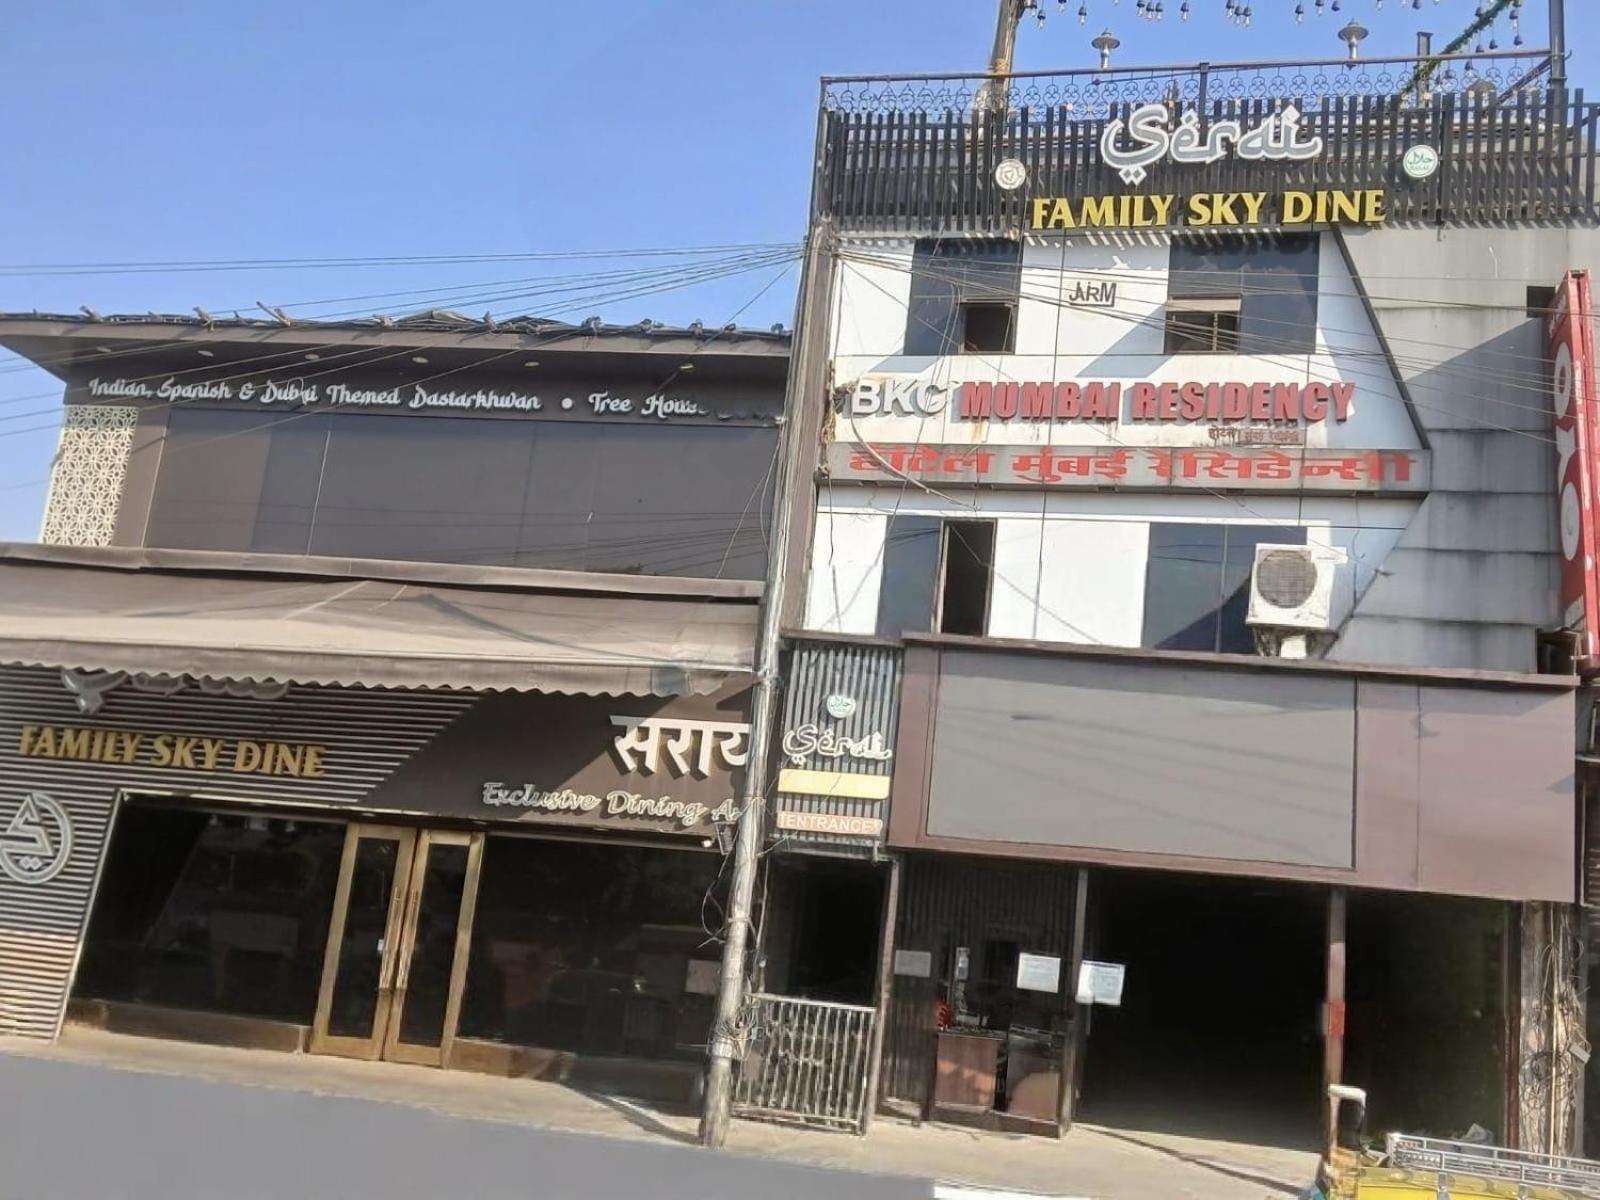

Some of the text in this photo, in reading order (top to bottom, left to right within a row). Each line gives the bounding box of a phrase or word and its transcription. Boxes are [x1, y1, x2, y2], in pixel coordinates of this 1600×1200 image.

[1031, 189, 1386, 229] FAMILY SKY DINE
[157, 376, 231, 402] Spanish
[239, 384, 255, 400] &
[261, 379, 318, 404] Dubai
[327, 384, 400, 406] Themed
[409, 385, 542, 411] Dastarkhwan
[588, 391, 633, 413] Tree
[959, 381, 1121, 420] MUMBAI
[1131, 381, 1355, 421] RESIDENCY
[18, 724, 327, 777] FAMILY SKY DINE
[483, 782, 602, 811] Exclusive
[607, 790, 708, 826] Dining
